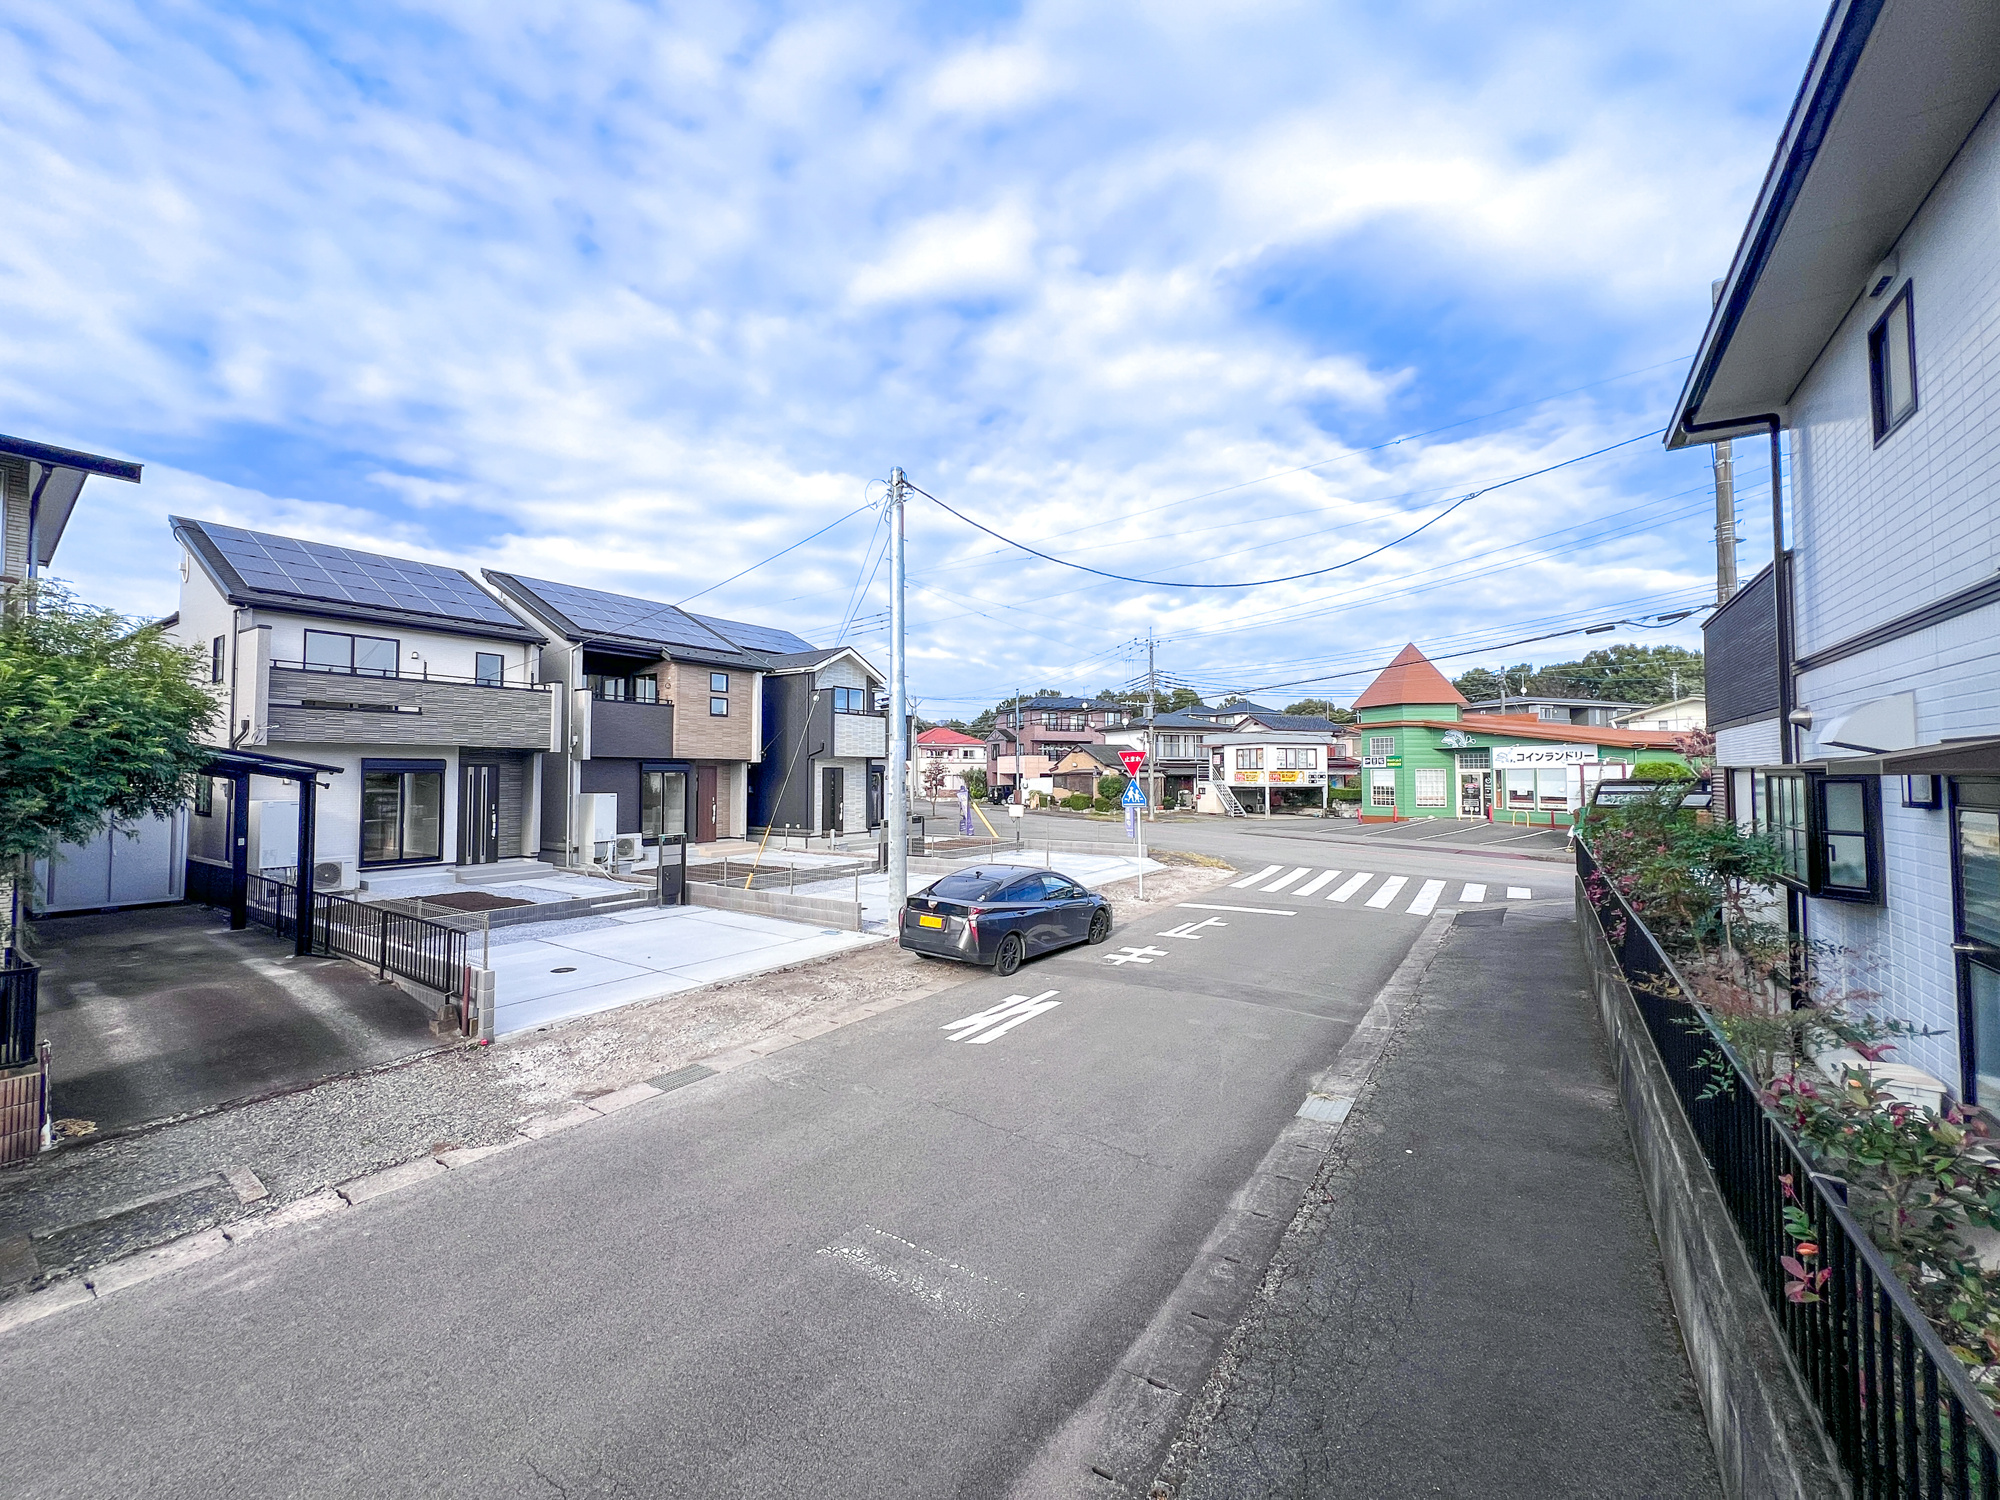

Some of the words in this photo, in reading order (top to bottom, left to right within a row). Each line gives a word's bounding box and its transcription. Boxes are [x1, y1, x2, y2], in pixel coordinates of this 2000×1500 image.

[1124, 755, 1142, 763] 止まれ
[1516, 751, 1595, 762] コインランドリー
